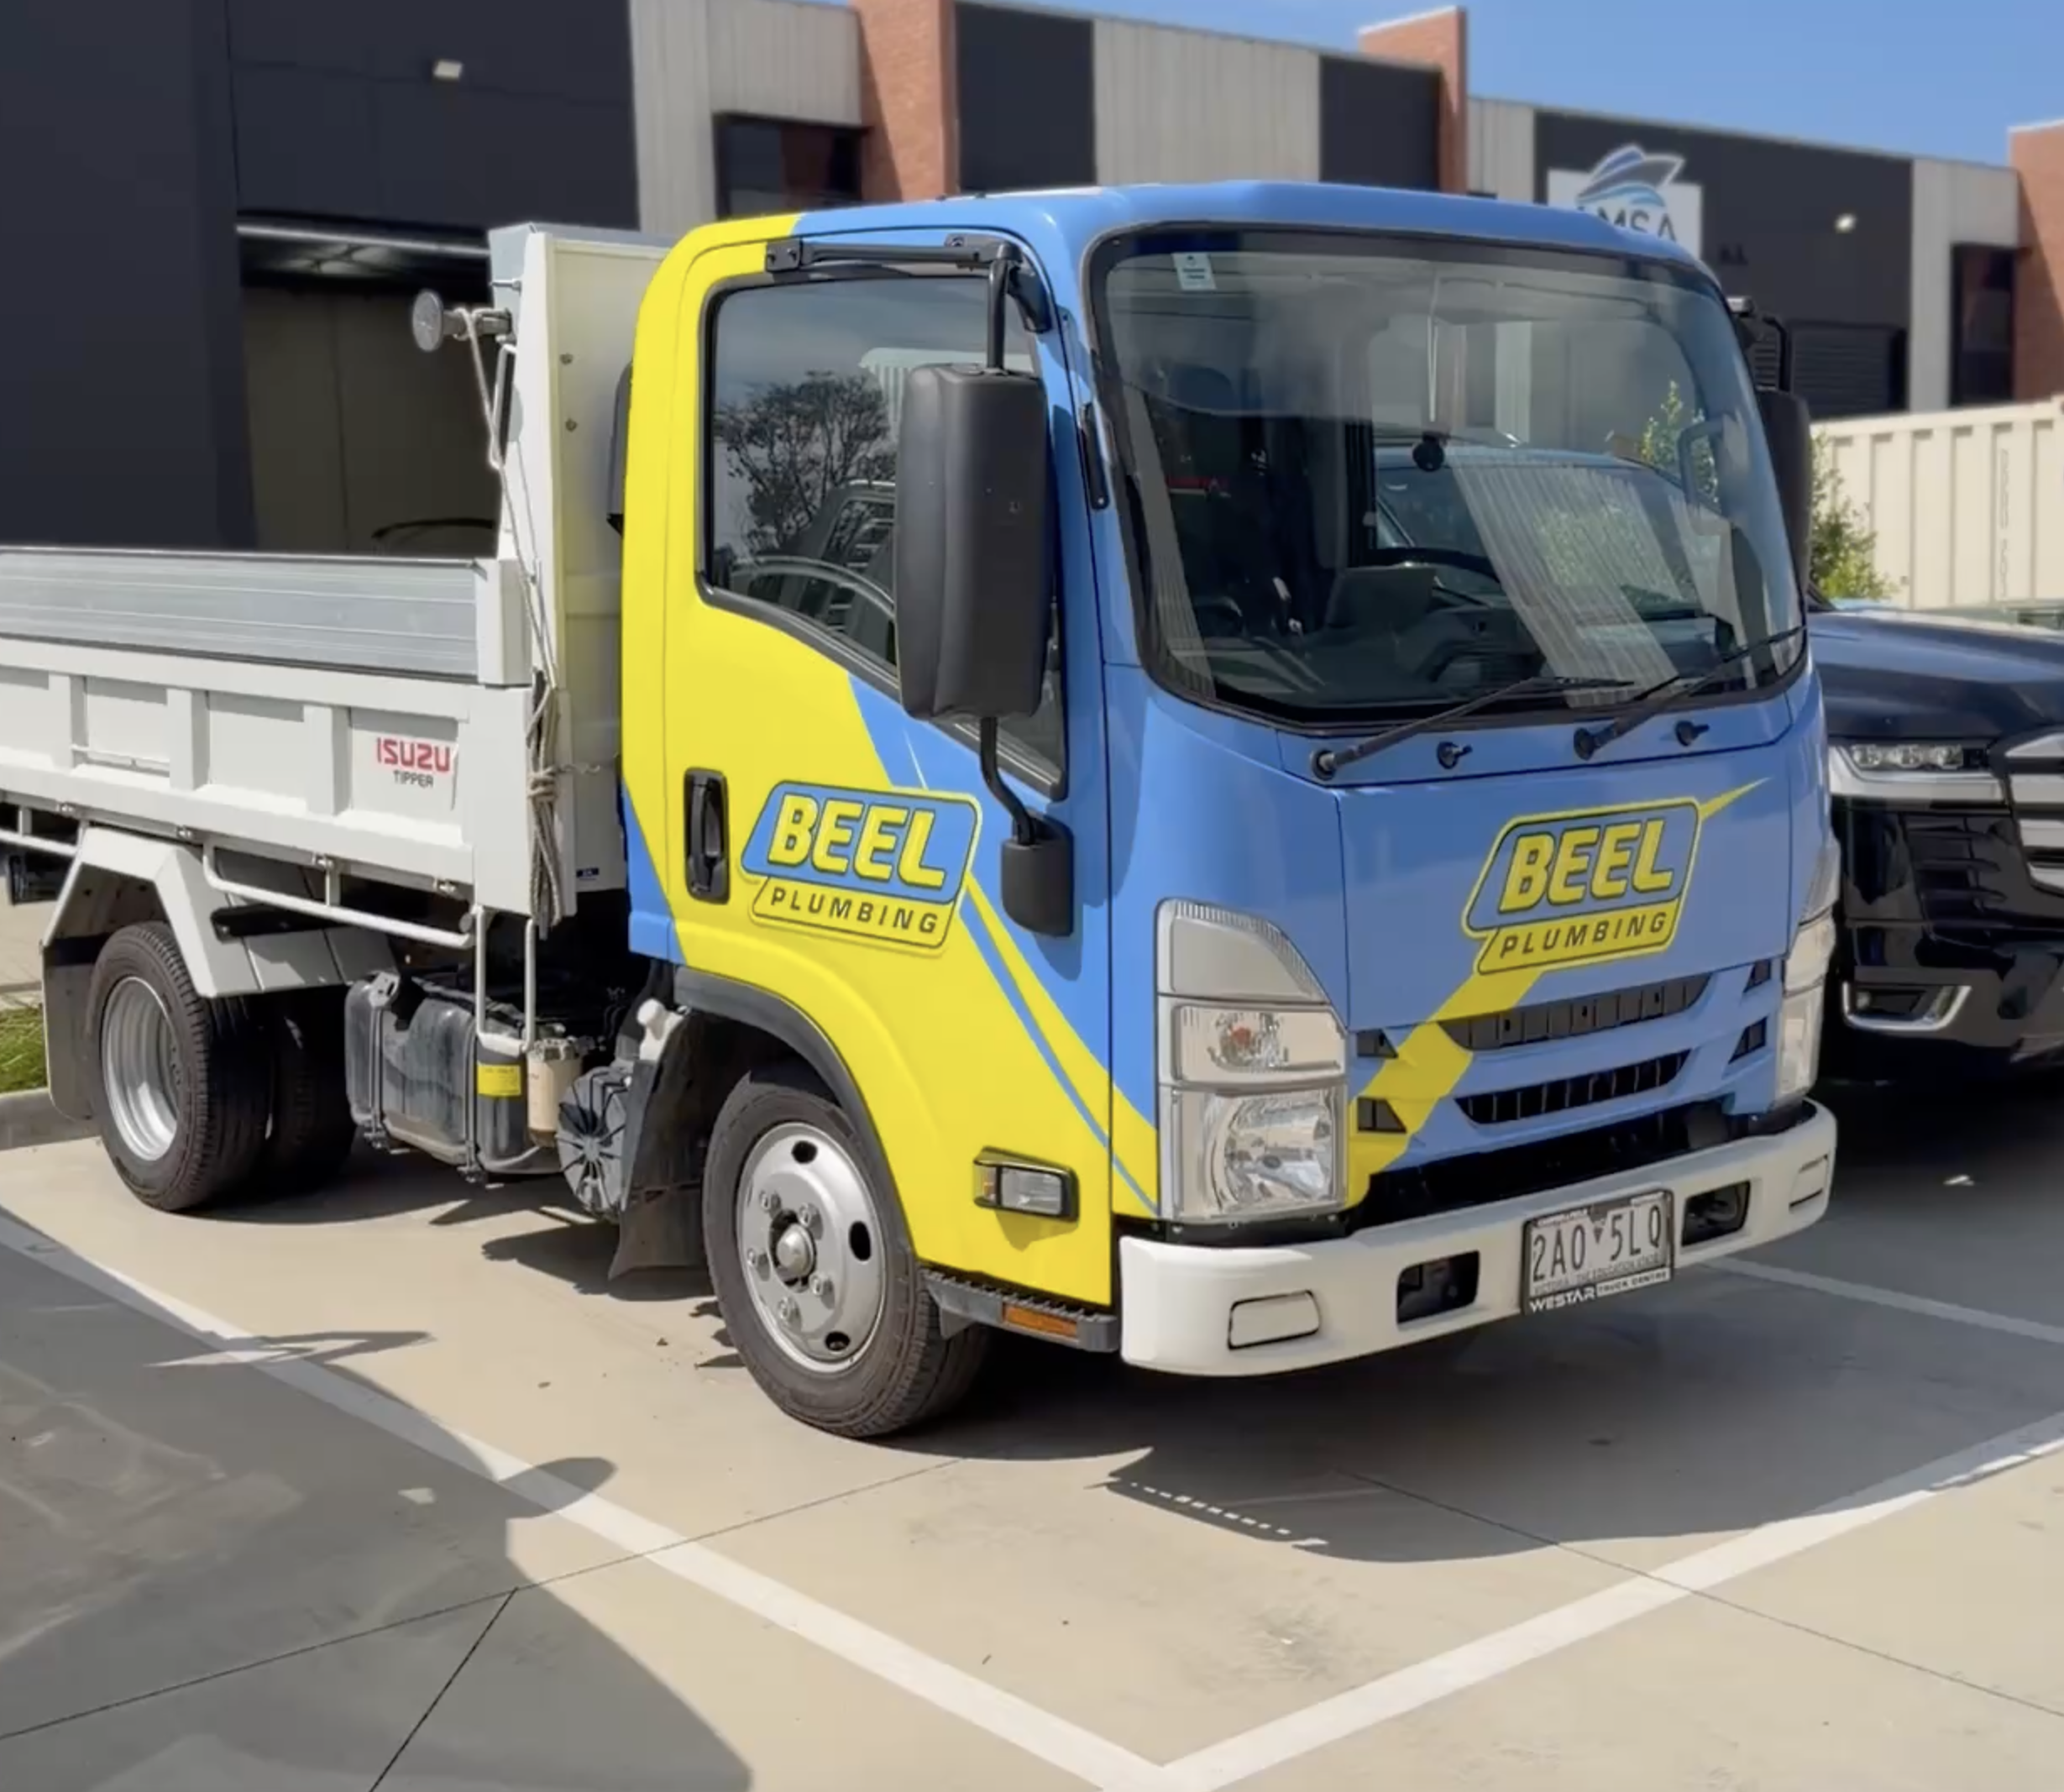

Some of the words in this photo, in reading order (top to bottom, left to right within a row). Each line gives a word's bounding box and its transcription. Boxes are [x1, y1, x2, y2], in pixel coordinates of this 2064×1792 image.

[1576, 207, 1677, 242] MSA
[376, 736, 451, 772] ISUZU
[394, 769, 434, 789] TIPPER
[767, 793, 947, 891] BEEL
[1498, 817, 1674, 914] BEEL
[770, 886, 939, 934] PLUMBING
[1500, 912, 1668, 959] PLUMBING
[1610, 1205, 1661, 1262] 5LQ
[1530, 1286, 1595, 1313] WESTAR
[1599, 1277, 1629, 1293] TRUCK
[1632, 1270, 1668, 1286] CENTRE
